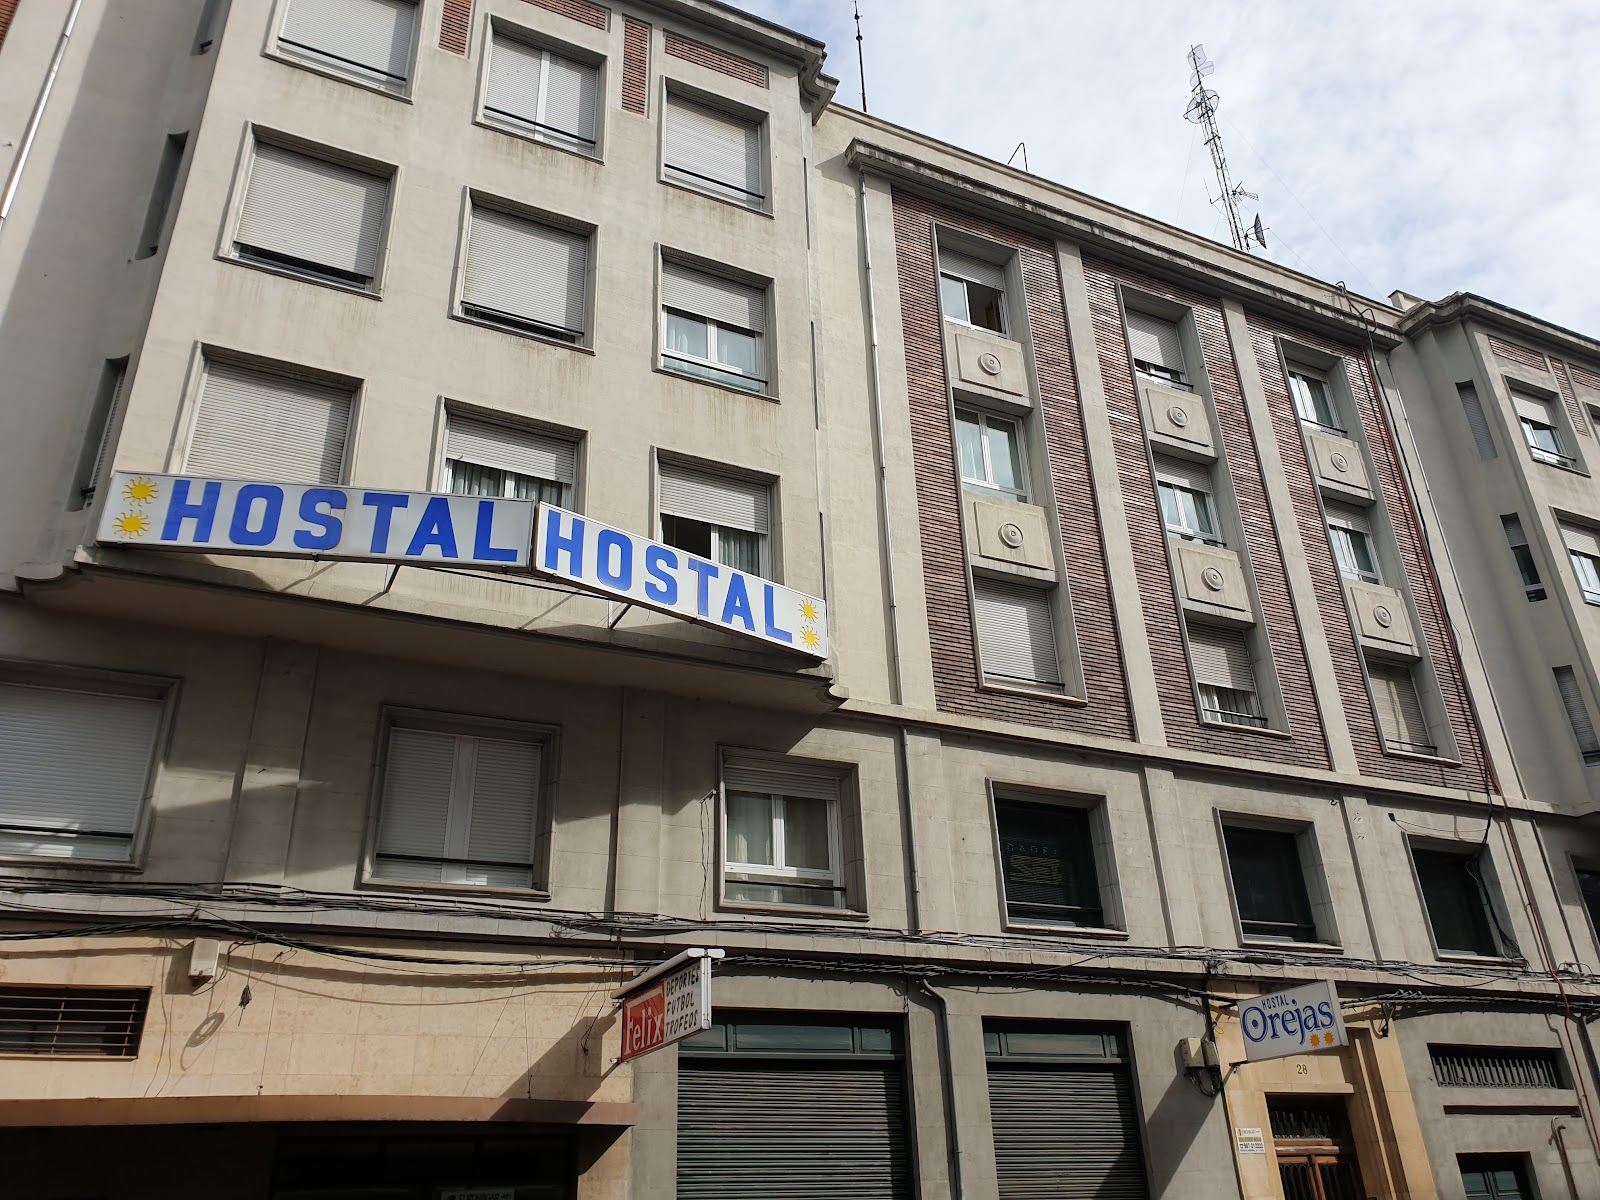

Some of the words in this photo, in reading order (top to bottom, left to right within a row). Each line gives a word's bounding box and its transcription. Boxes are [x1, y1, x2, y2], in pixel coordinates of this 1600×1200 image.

[160, 479, 520, 563] HOSTAL
[544, 513, 793, 644] HOSTAL
[666, 965, 700, 998] DEPORTES
[666, 990, 695, 1017] FUTBOL
[1261, 994, 1290, 1011] HOSTAL
[623, 984, 664, 1056] Felix
[665, 1009, 699, 1038] TROFEOS
[1241, 998, 1336, 1047] Orejas
[1296, 1063, 1308, 1075] 28
